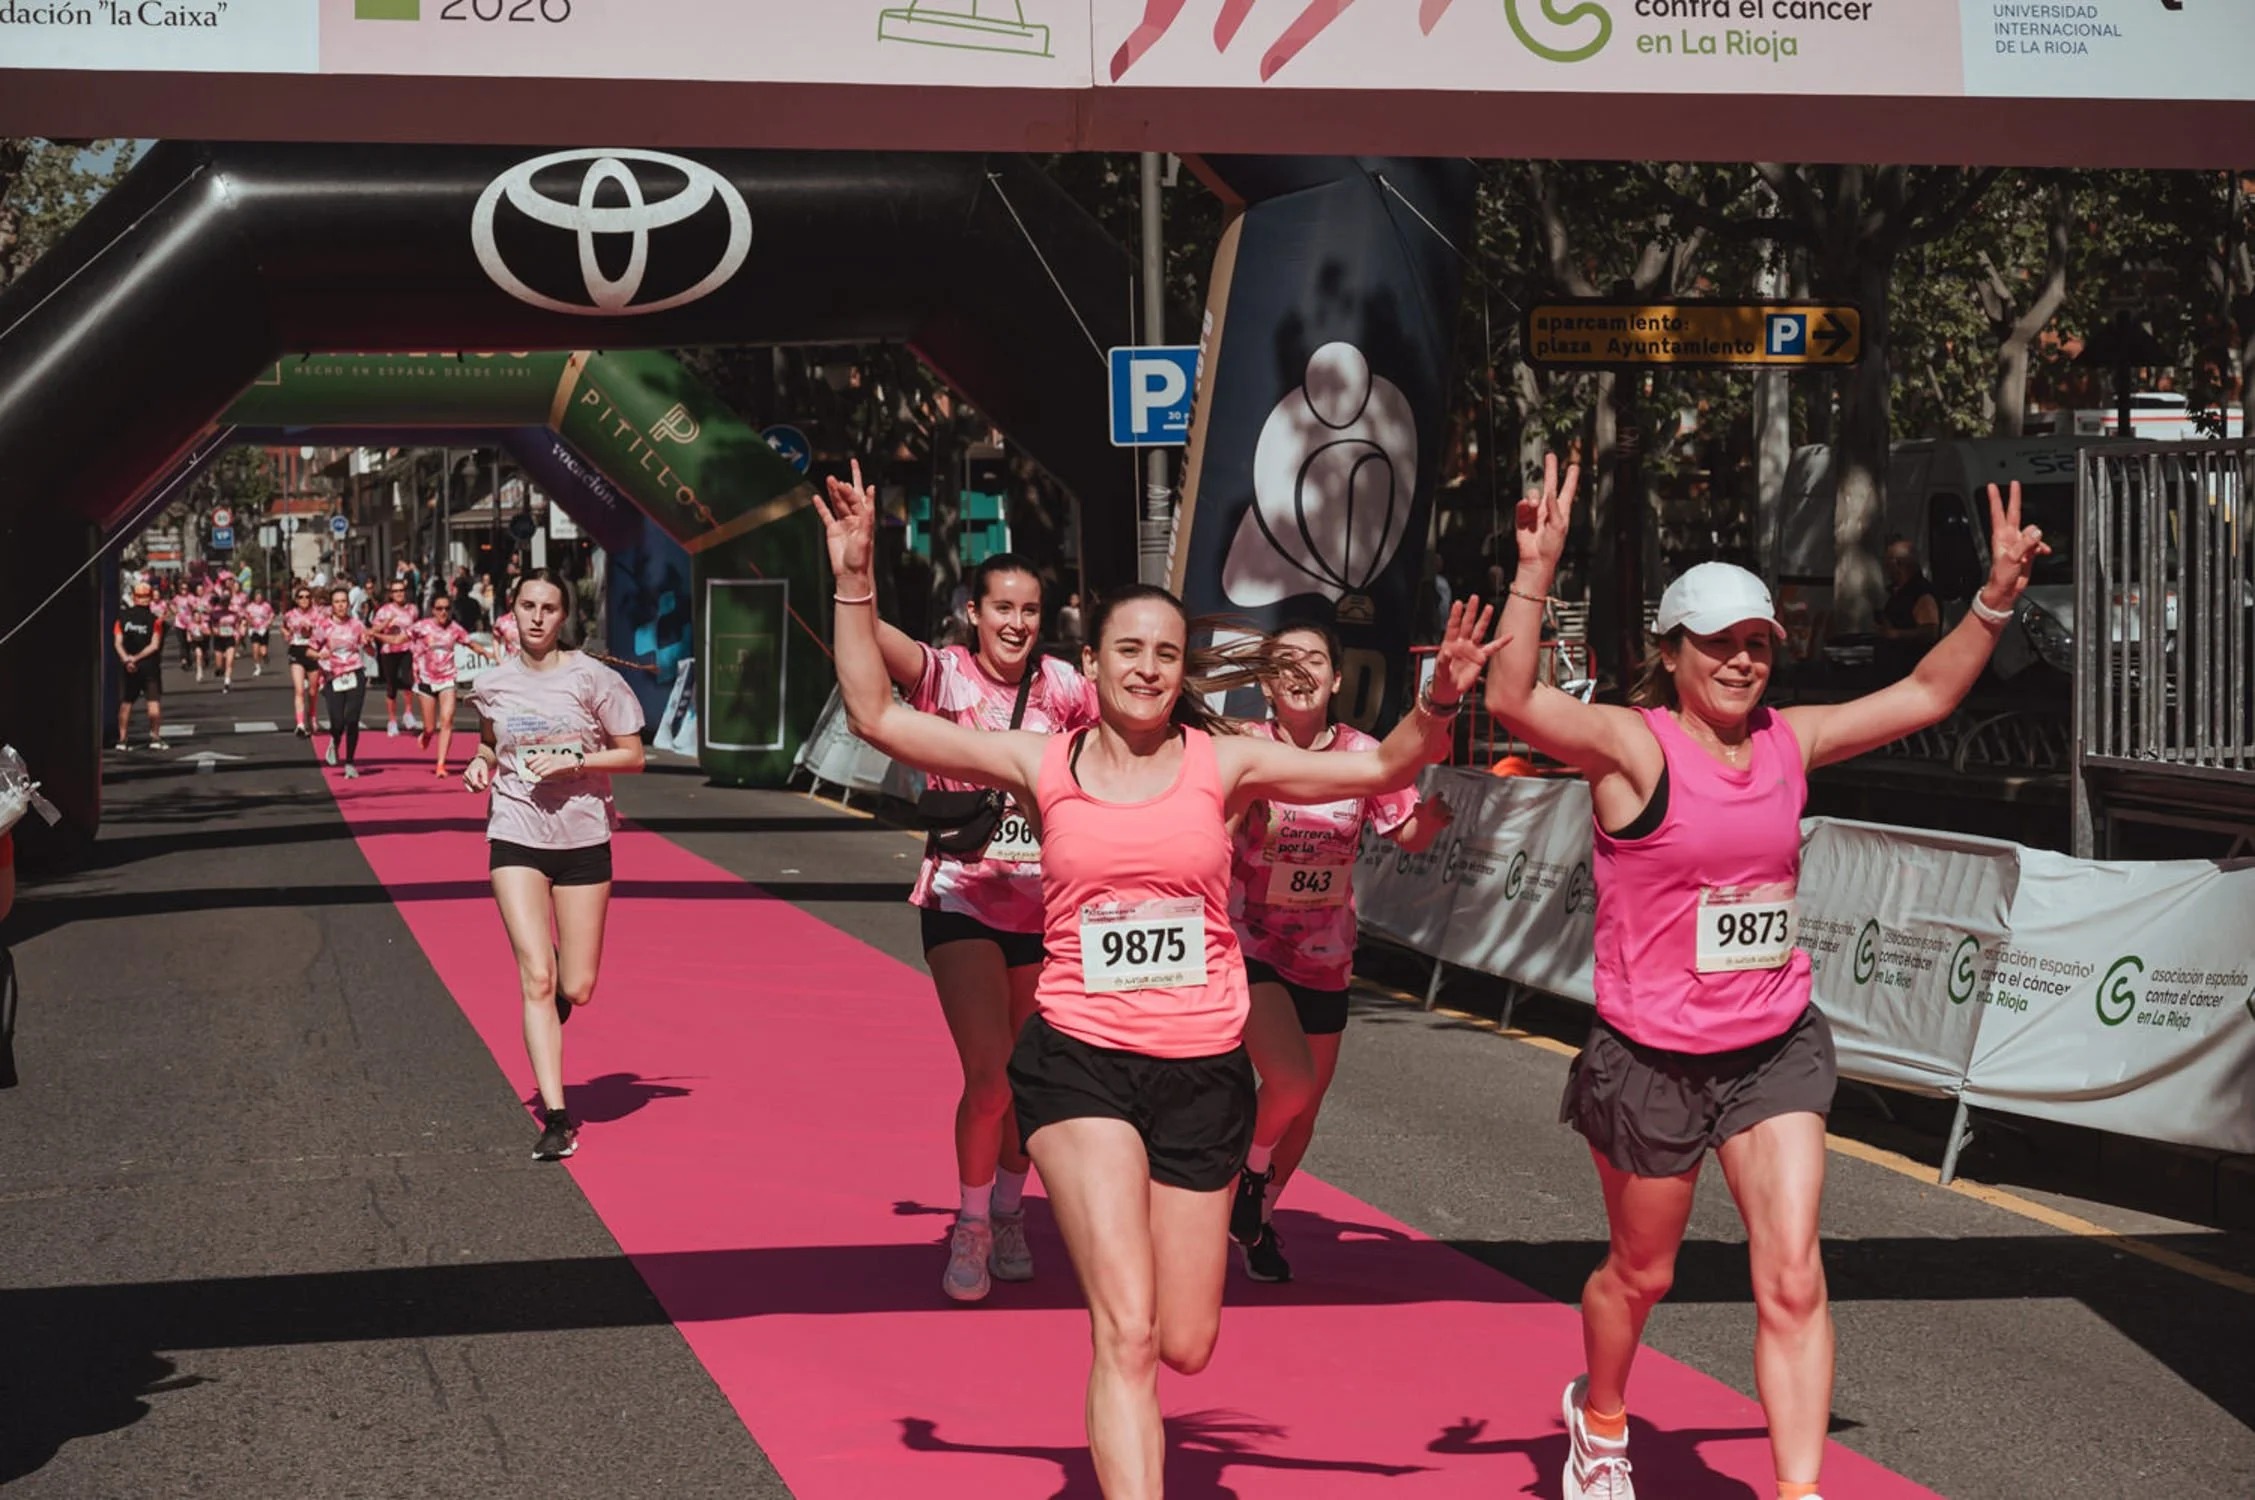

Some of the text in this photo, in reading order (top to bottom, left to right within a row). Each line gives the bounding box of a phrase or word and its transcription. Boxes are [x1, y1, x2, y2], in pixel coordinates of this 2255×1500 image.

[1635, 0, 1730, 18] contra
[1739, 0, 1763, 19] el
[1993, 4, 2099, 19] UNIVERSIDAD
[1994, 22, 2123, 37] INTERNACIONAL
[1636, 29, 1798, 62] en La Rioja
[1995, 40, 2089, 55] DE LA RIOJA
[1772, 317, 1800, 353] P
[1536, 337, 1757, 359] plaza Ayuntamiento
[1130, 359, 1187, 433] P
[1280, 826, 1333, 840] Carrera
[1290, 871, 1332, 893] 843
[1717, 909, 1788, 948] 9873
[1102, 927, 1186, 967] 9875
[2008, 972, 2022, 987] el
[1997, 990, 2028, 1014] Rioja
[2145, 988, 2179, 1005] contra
[2137, 1010, 2192, 1032] en La Rioja
